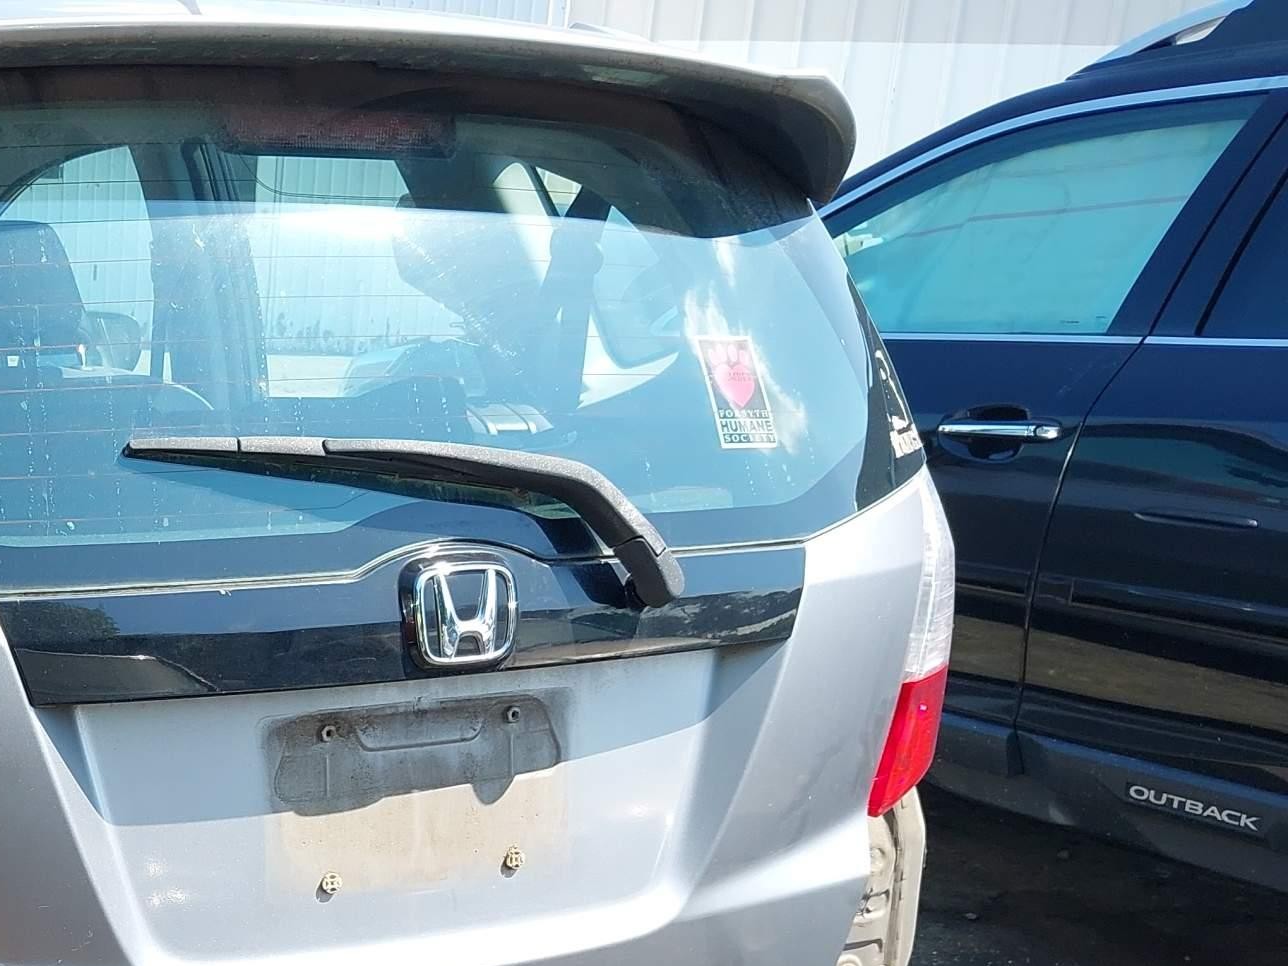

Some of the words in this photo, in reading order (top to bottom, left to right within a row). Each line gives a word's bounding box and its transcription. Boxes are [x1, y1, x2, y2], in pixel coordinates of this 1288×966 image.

[720, 420, 773, 433] HUMANE
[724, 433, 775, 442] SOCIETY
[1129, 785, 1261, 831] OUTBACK
